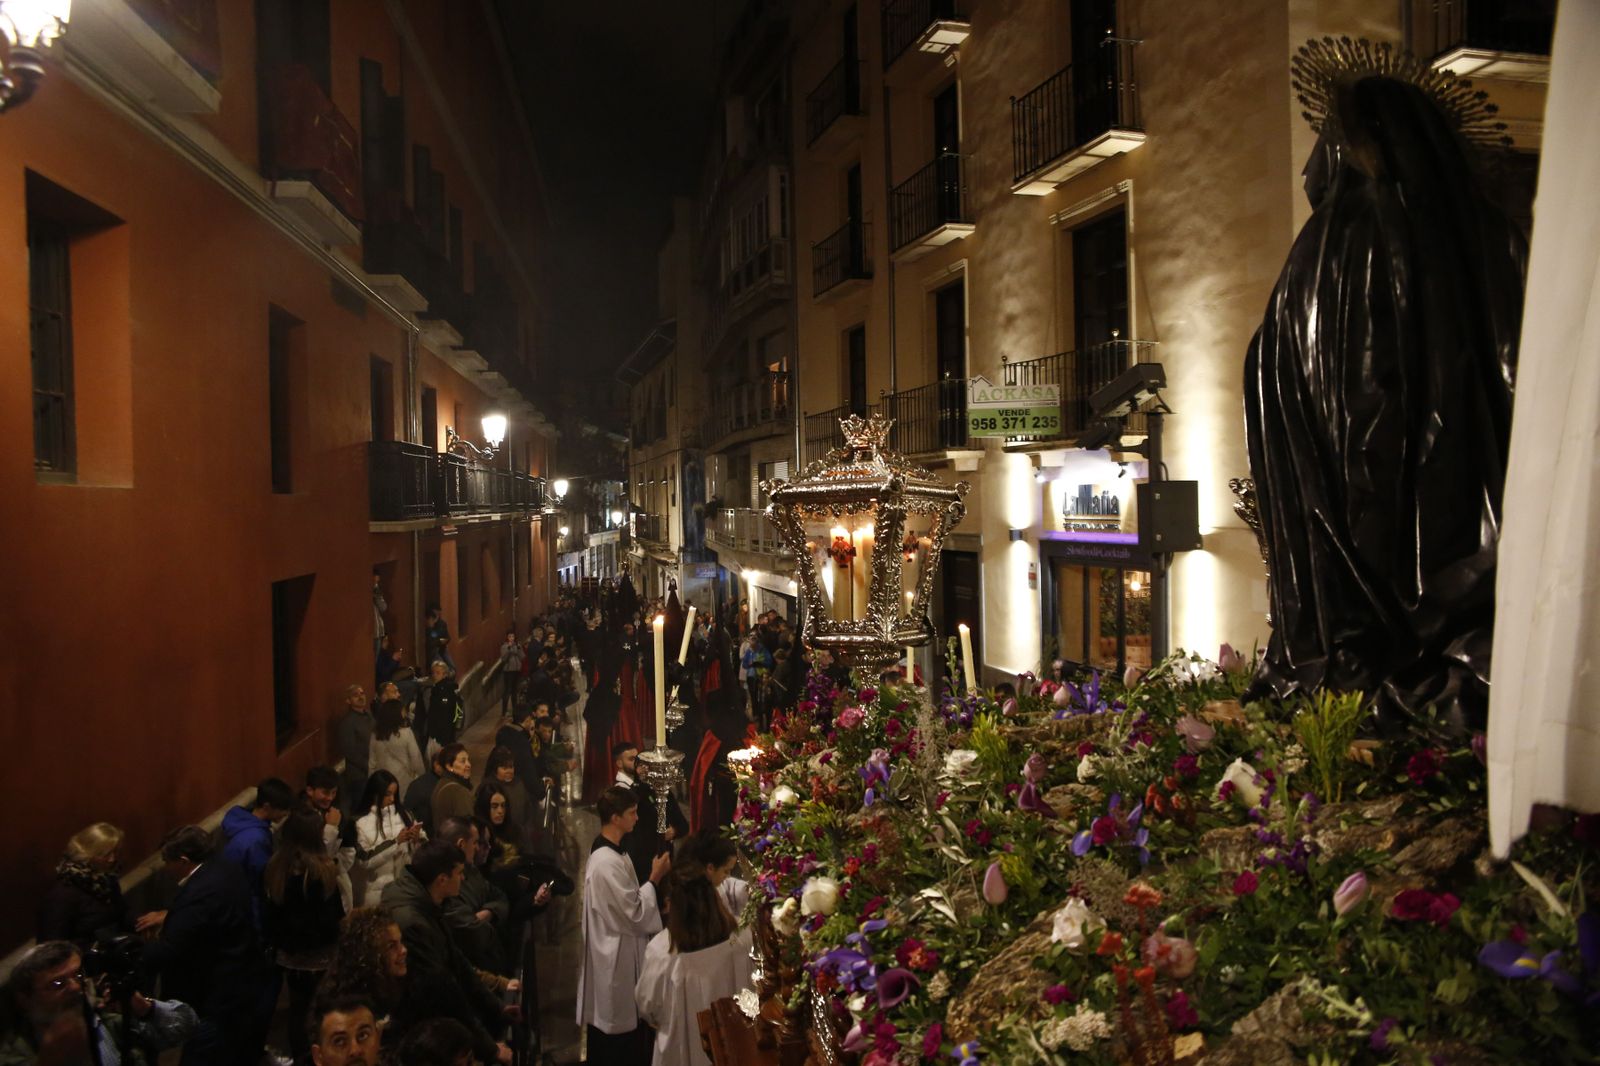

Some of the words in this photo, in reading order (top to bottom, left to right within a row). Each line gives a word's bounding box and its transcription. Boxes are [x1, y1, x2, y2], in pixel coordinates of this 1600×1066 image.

[977, 386, 1057, 401] ACKASA
[998, 408, 1031, 417] VENDE
[971, 418, 997, 431] 958
[1002, 417, 1027, 430] 371
[1032, 416, 1059, 429] 235
